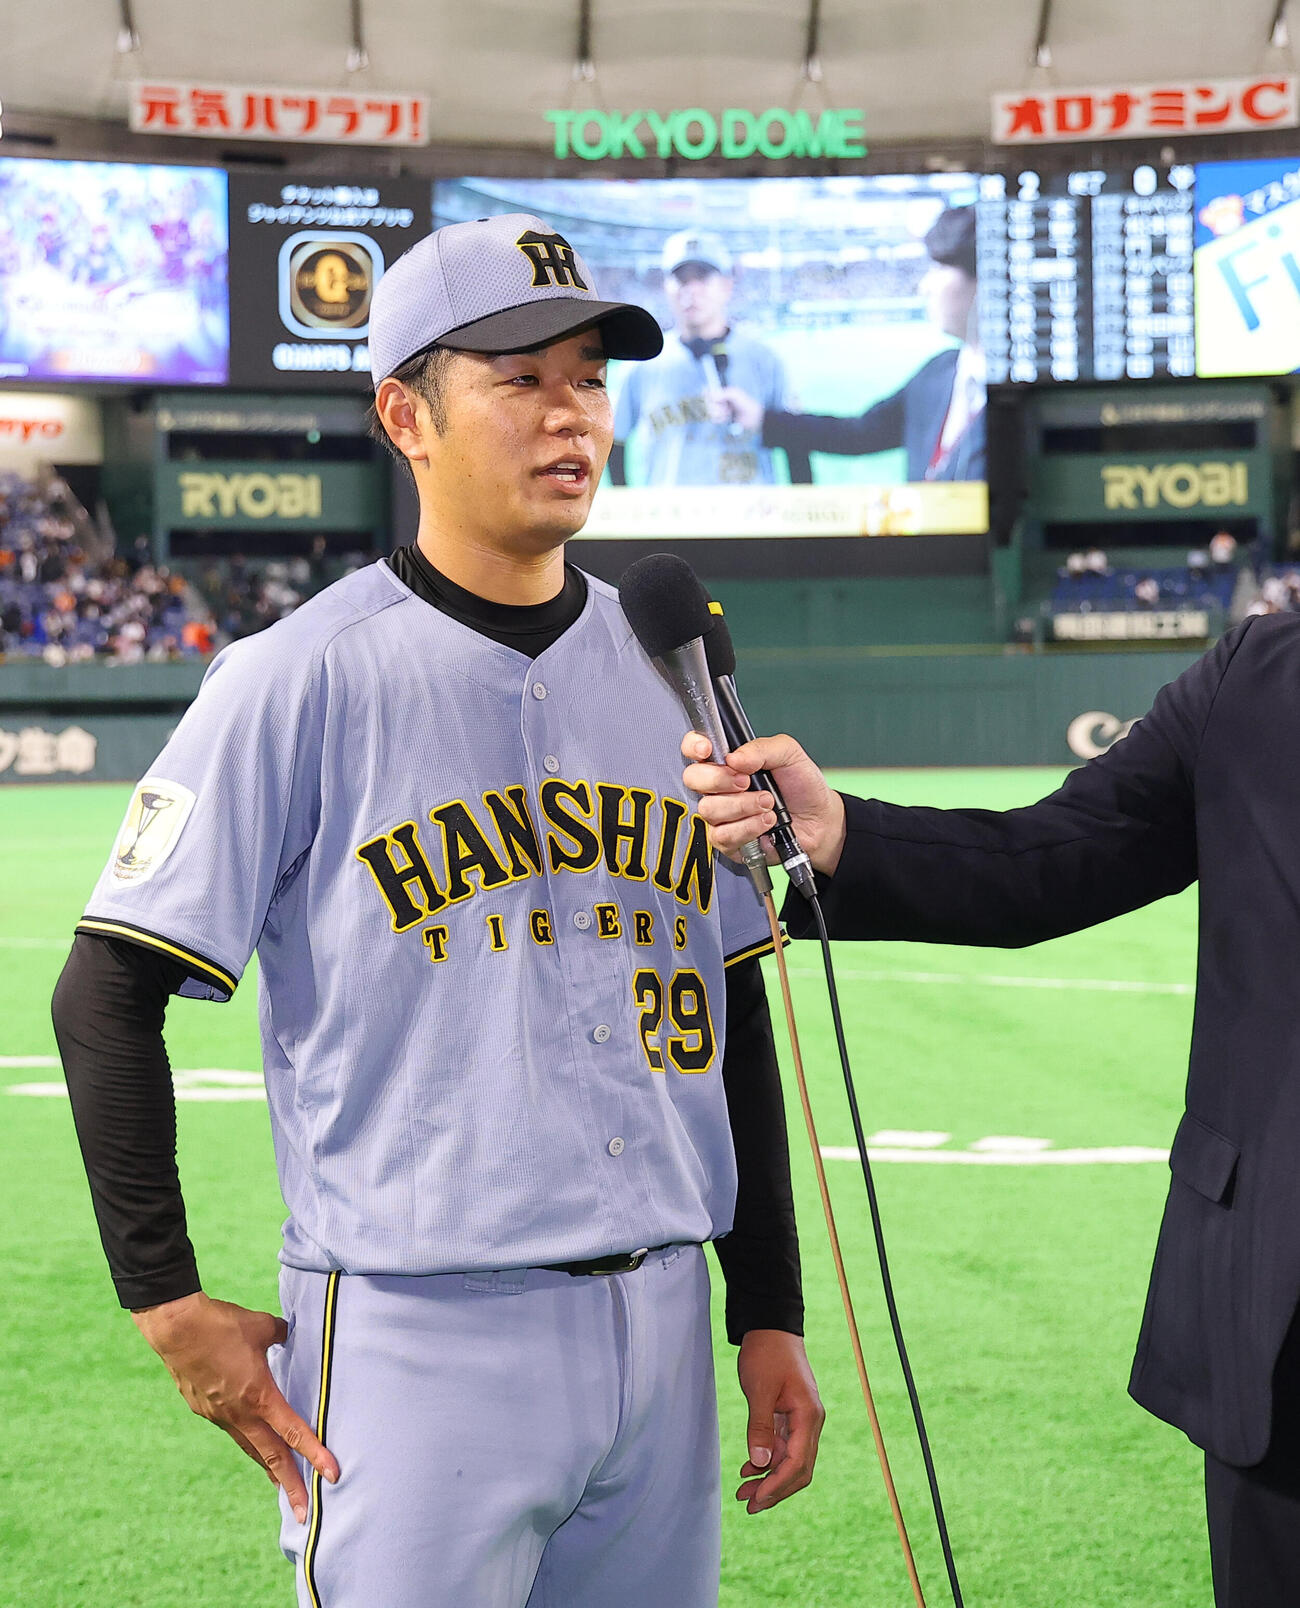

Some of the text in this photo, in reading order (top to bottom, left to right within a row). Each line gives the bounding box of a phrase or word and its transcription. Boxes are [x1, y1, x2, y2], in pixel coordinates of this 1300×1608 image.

[542, 107, 868, 160] TOKYO DOME
[1004, 81, 1289, 136] オロナミンC
[179, 472, 322, 519] RYOBI
[1101, 461, 1248, 509] RYOBI
[355, 777, 718, 934] HANSHIN
[422, 902, 688, 963] TIGERS
[631, 967, 718, 1075] 29
